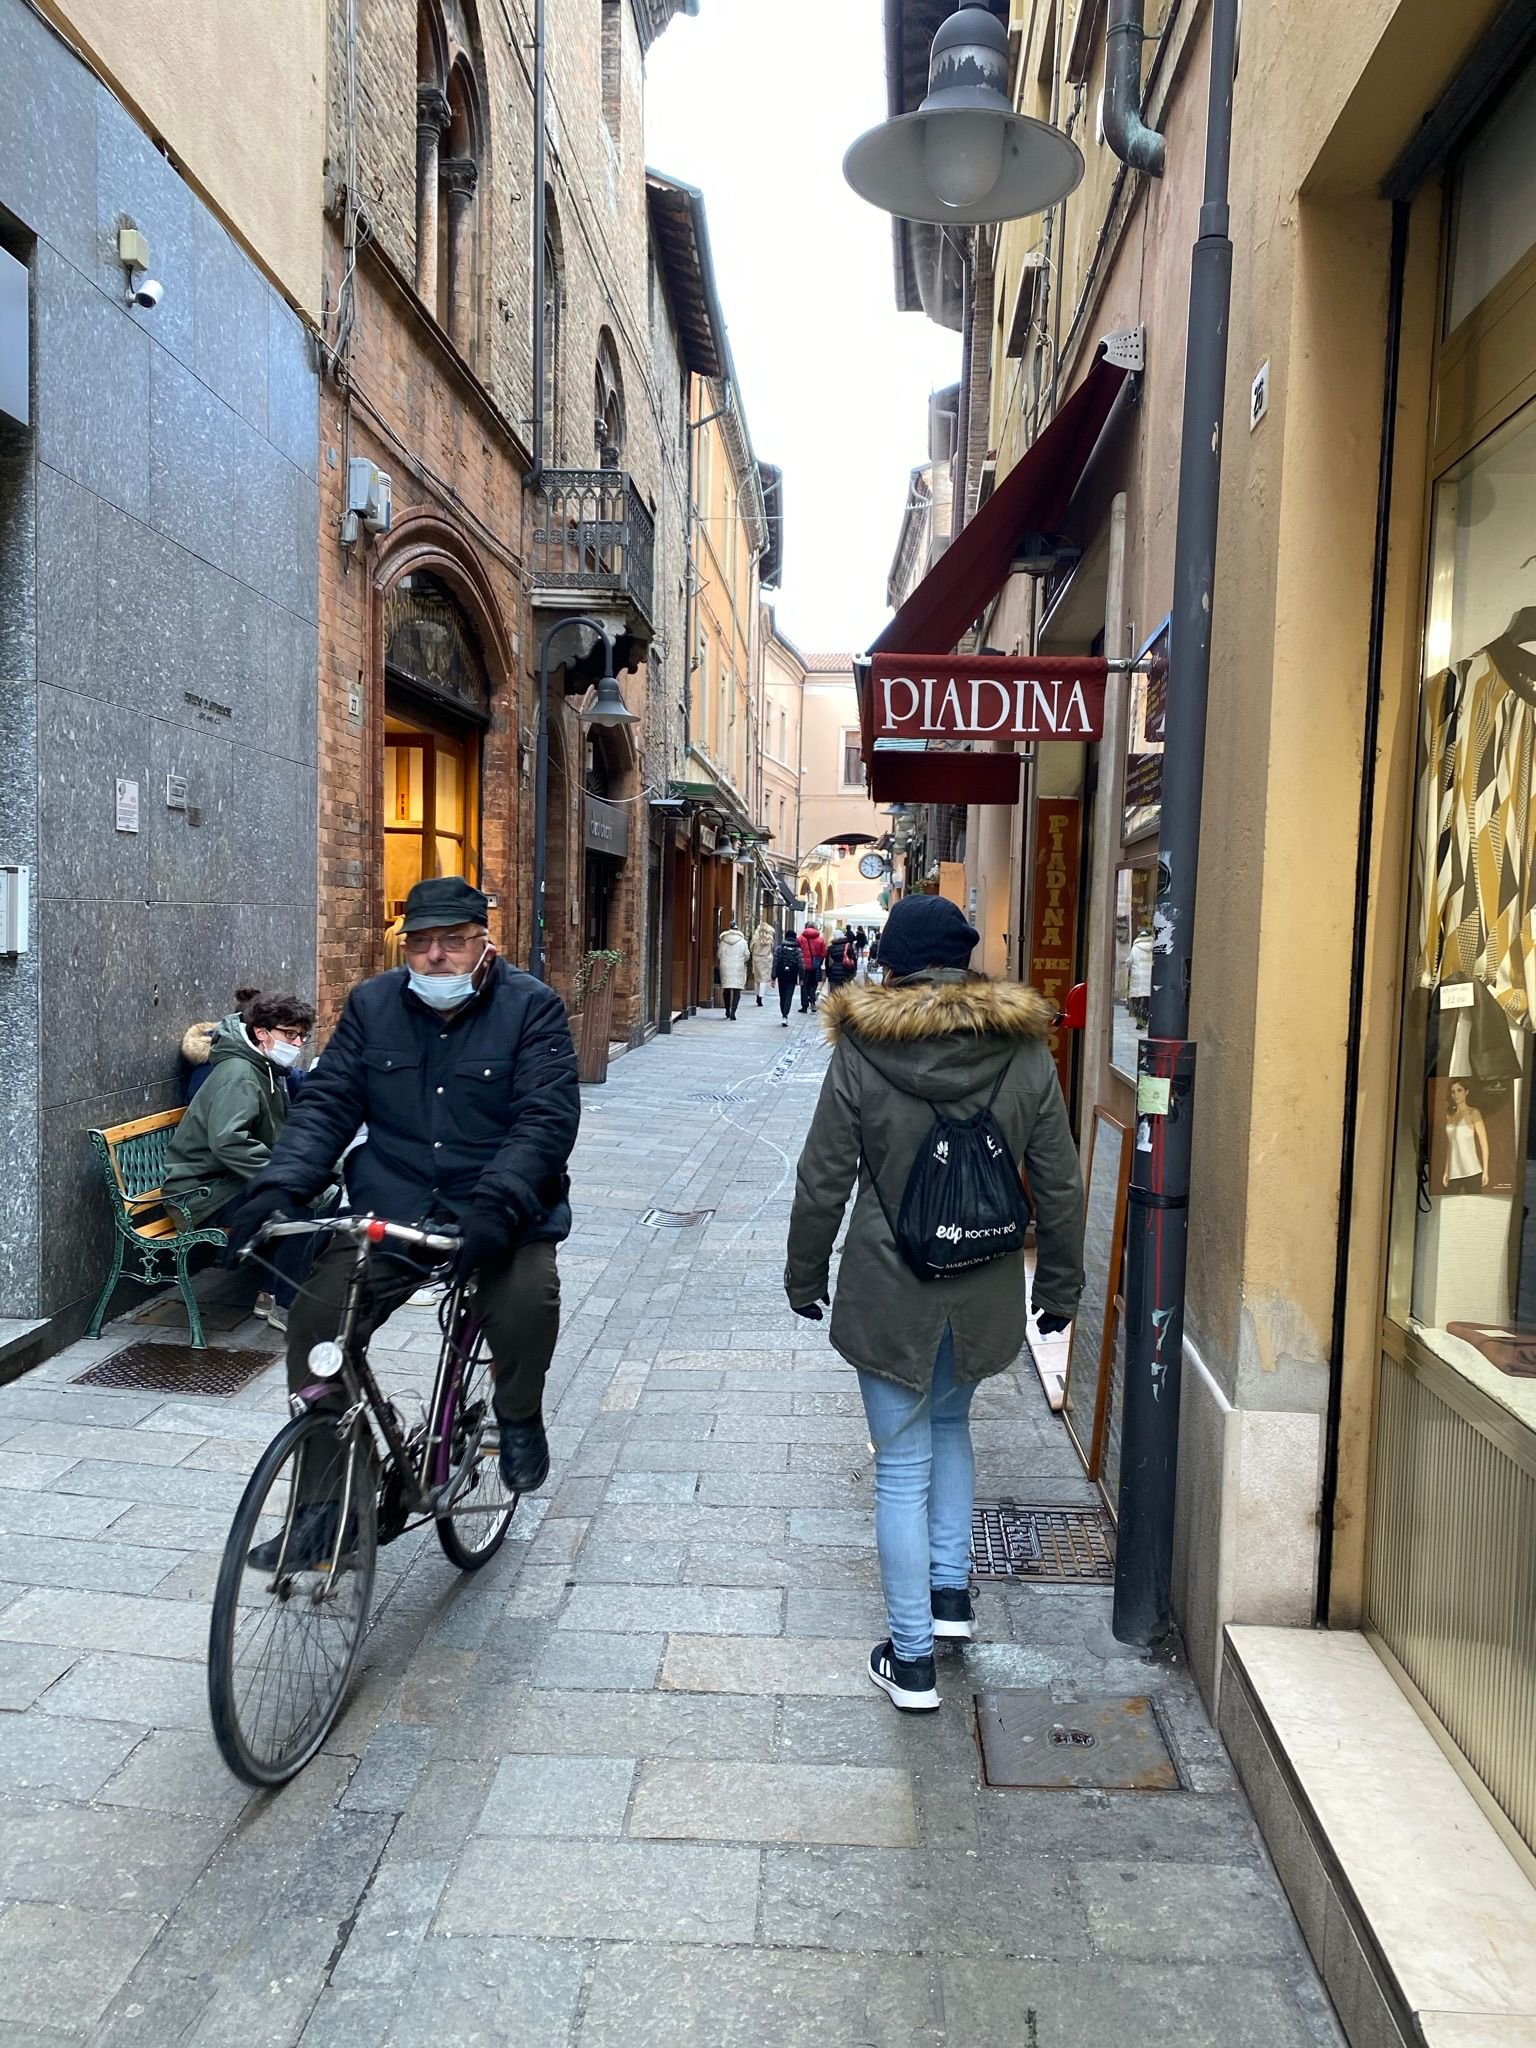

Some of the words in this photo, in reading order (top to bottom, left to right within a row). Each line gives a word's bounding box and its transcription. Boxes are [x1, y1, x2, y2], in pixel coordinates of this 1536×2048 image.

[880, 677, 1093, 733] PIADINA
[1041, 815, 1069, 945] PIADINA
[1033, 958, 1070, 970] THE
[936, 1223, 962, 1245] edp
